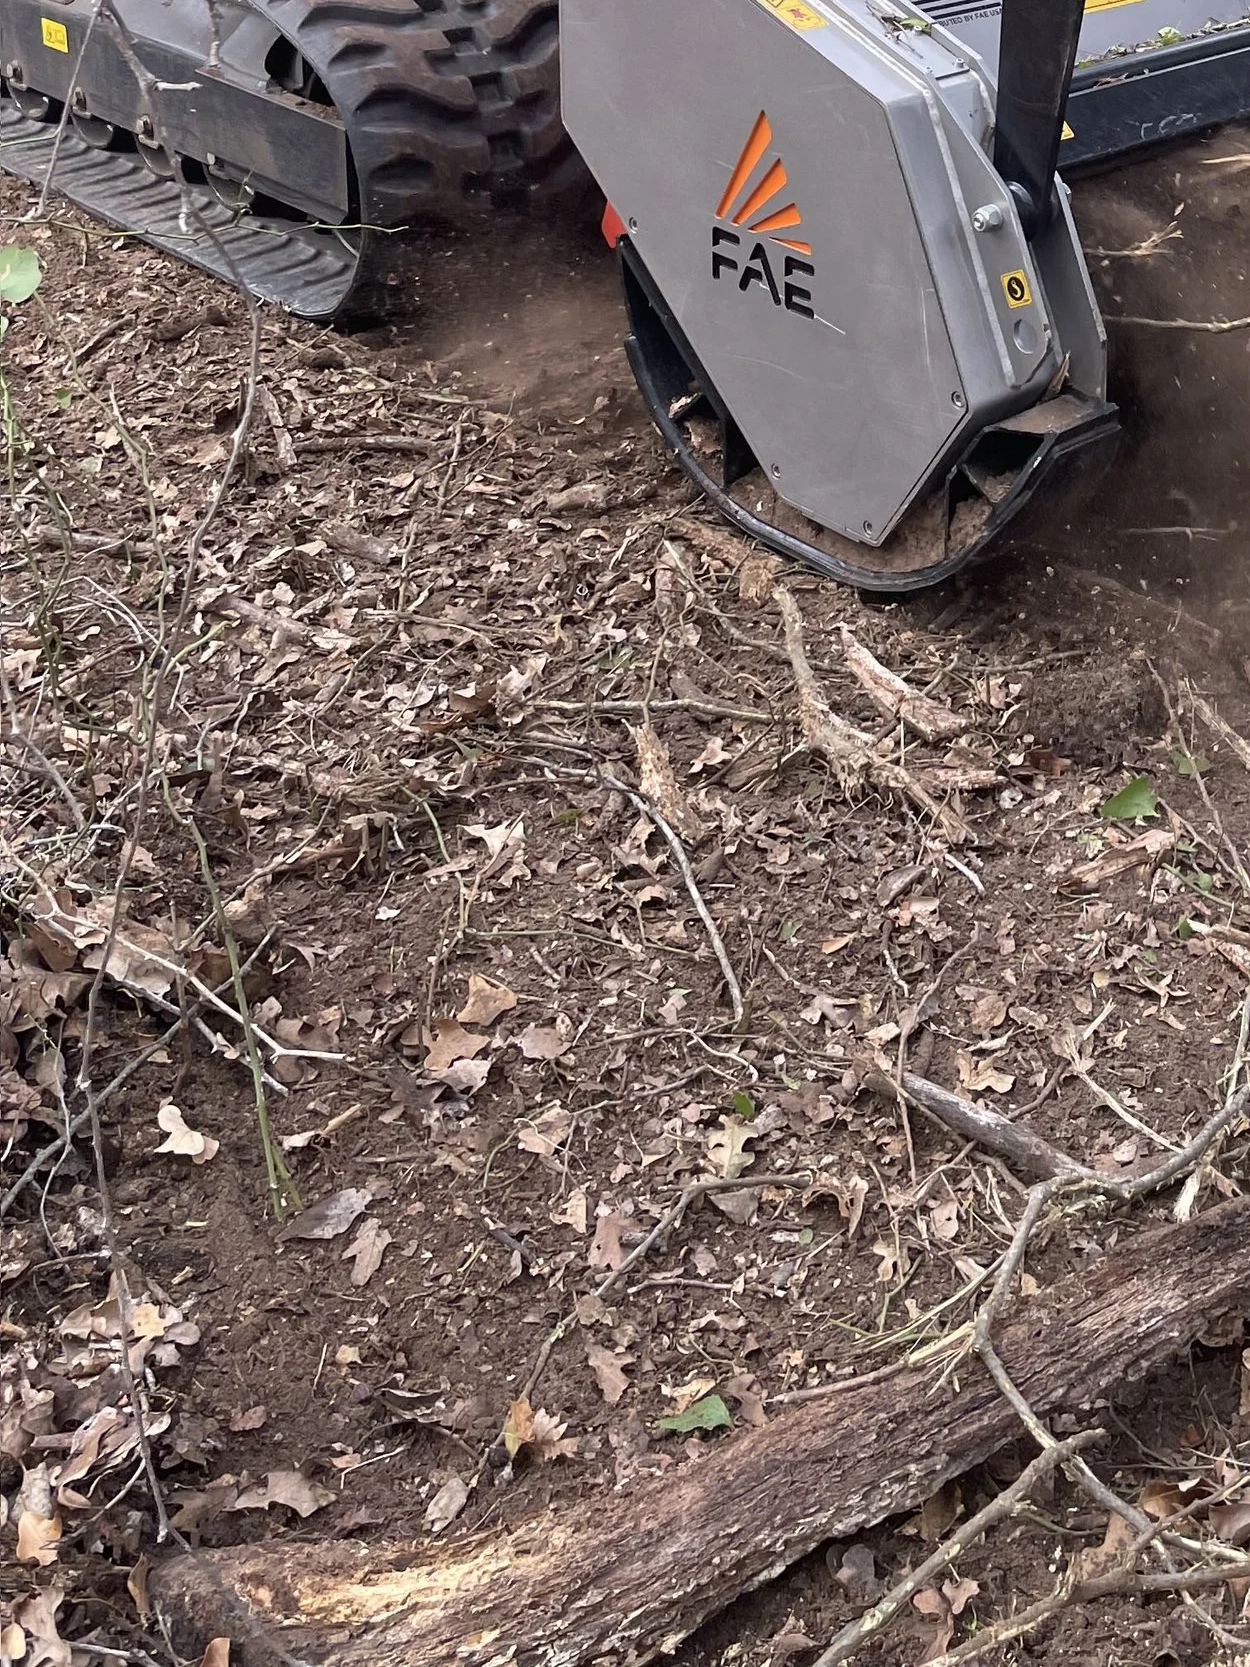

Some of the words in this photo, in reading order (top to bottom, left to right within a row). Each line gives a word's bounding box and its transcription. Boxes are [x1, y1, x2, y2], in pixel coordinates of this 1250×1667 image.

[964, 13, 975, 22] BY
[975, 10, 991, 21] FAE
[711, 226, 816, 321] FAE
